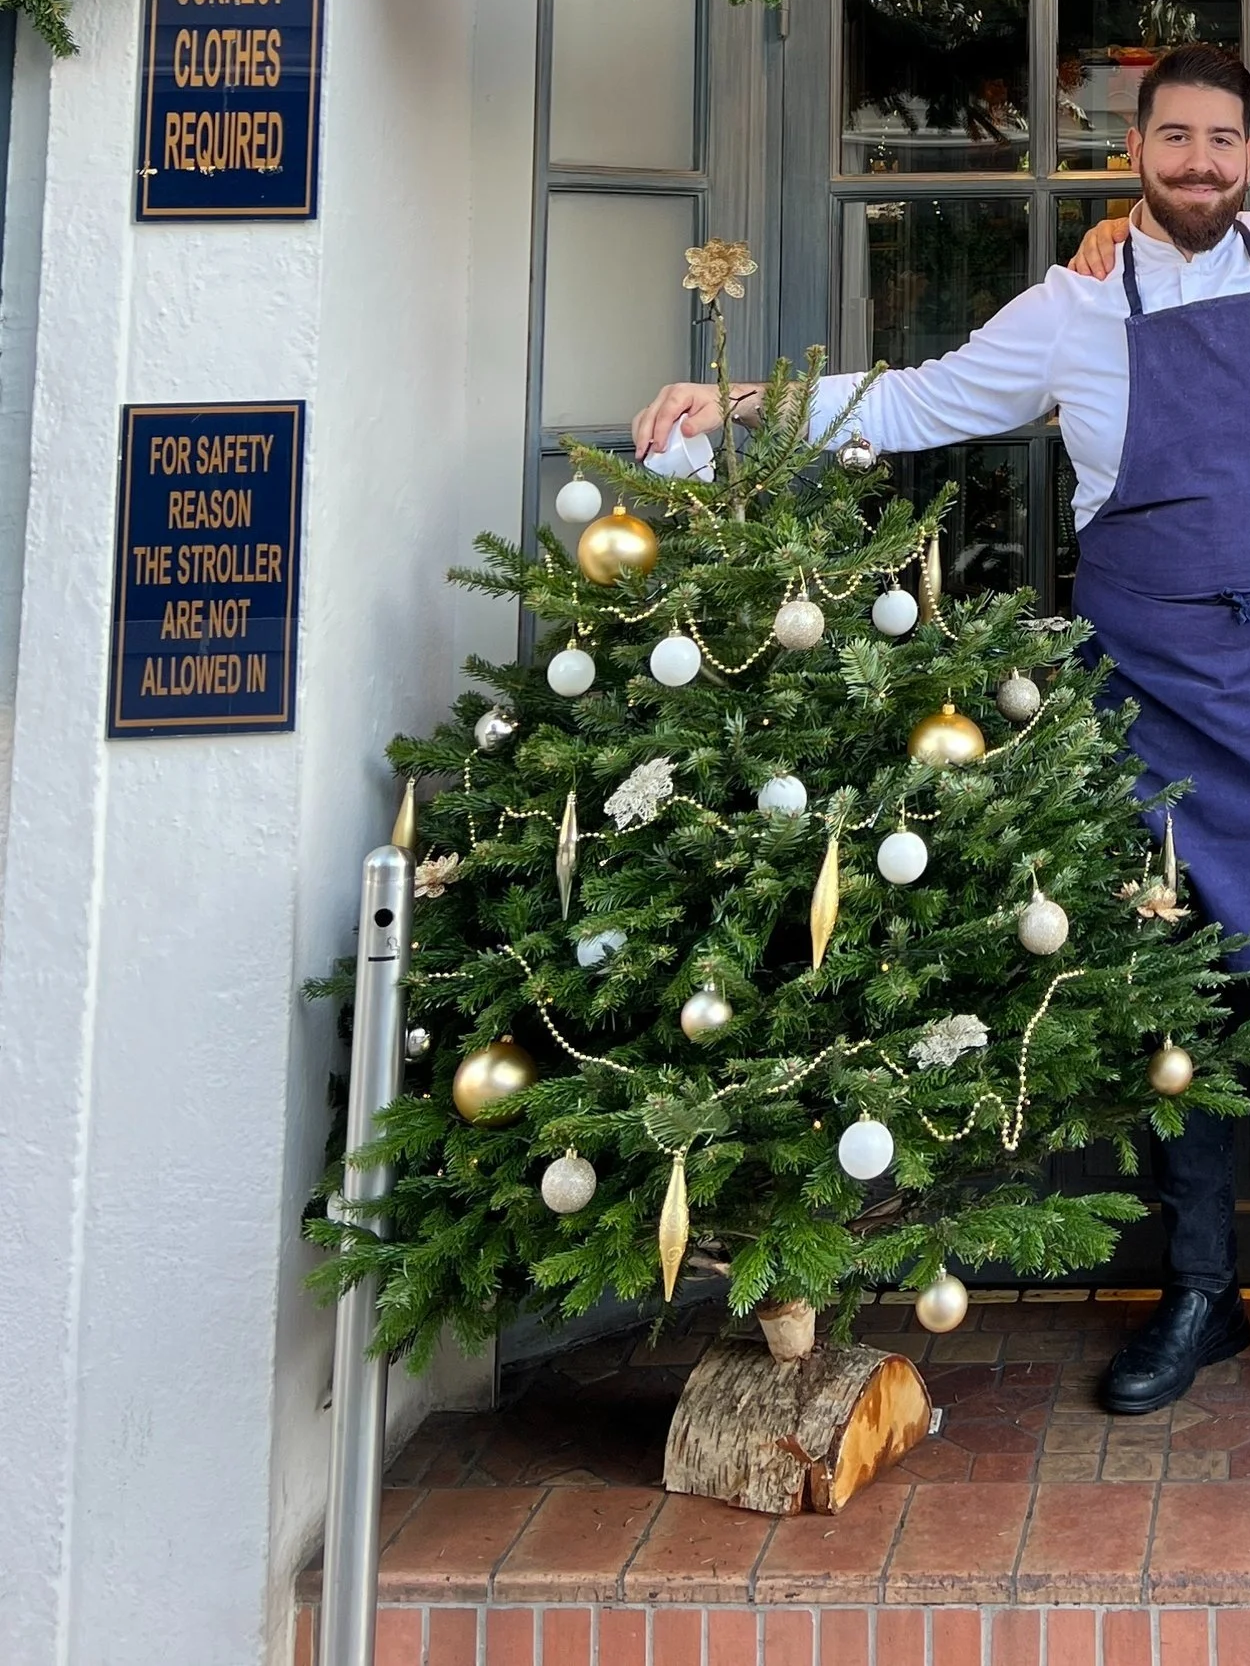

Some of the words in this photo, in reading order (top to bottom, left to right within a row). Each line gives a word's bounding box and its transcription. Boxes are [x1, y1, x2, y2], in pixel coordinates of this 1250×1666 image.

[173, 28, 281, 88] CLOTHES
[164, 111, 283, 170] REQUIRED
[150, 436, 191, 475] FOR
[196, 434, 274, 474] SAFETY
[168, 489, 252, 529] REASON
[133, 546, 172, 585] THE
[177, 544, 282, 584] STROLLER
[160, 601, 203, 640] ARE
[209, 599, 251, 638] NOT
[140, 655, 241, 696] ALLOWED
[246, 654, 267, 693] IN
